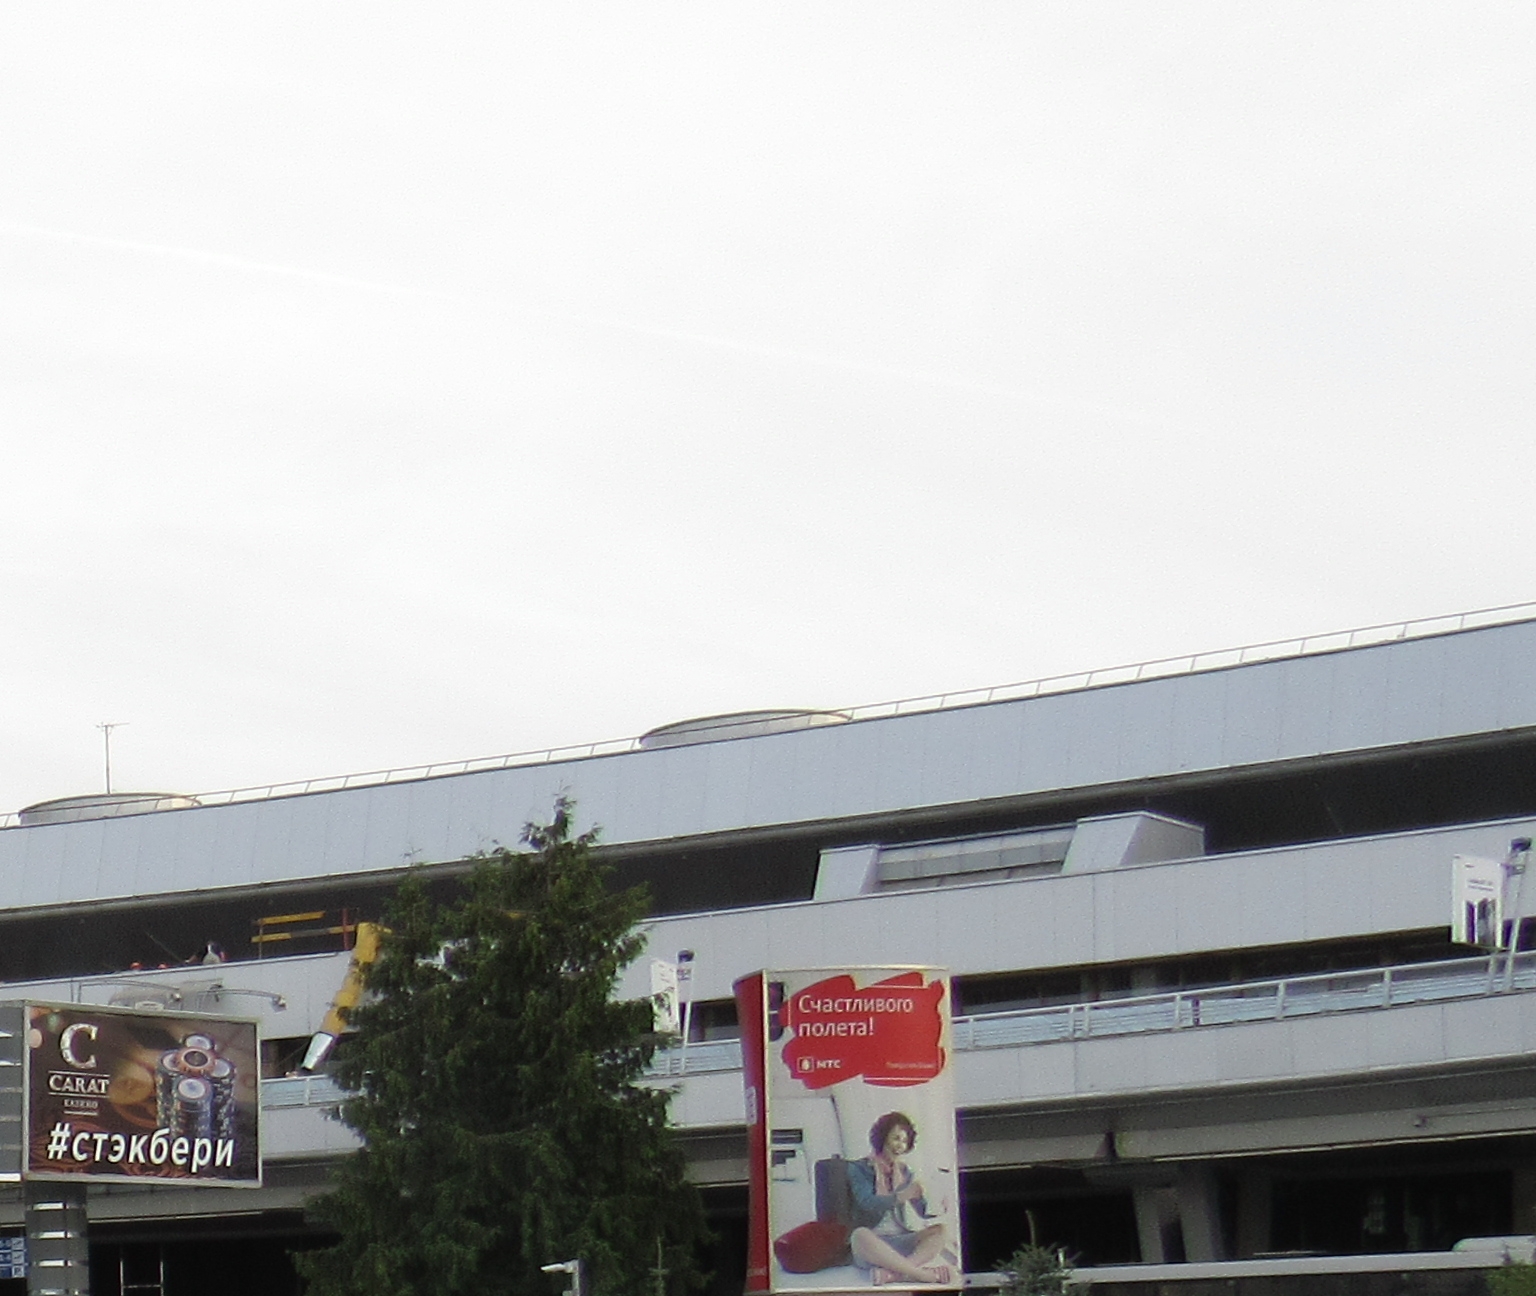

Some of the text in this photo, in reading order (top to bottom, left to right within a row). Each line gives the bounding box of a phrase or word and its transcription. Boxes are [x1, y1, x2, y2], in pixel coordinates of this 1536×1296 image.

[798, 995, 913, 1013] Счастливого
[798, 1017, 875, 1037] полета!
[59, 1023, 99, 1070] C
[49, 1074, 110, 1094] CARAT
[47, 1121, 235, 1174] #стэкбери
